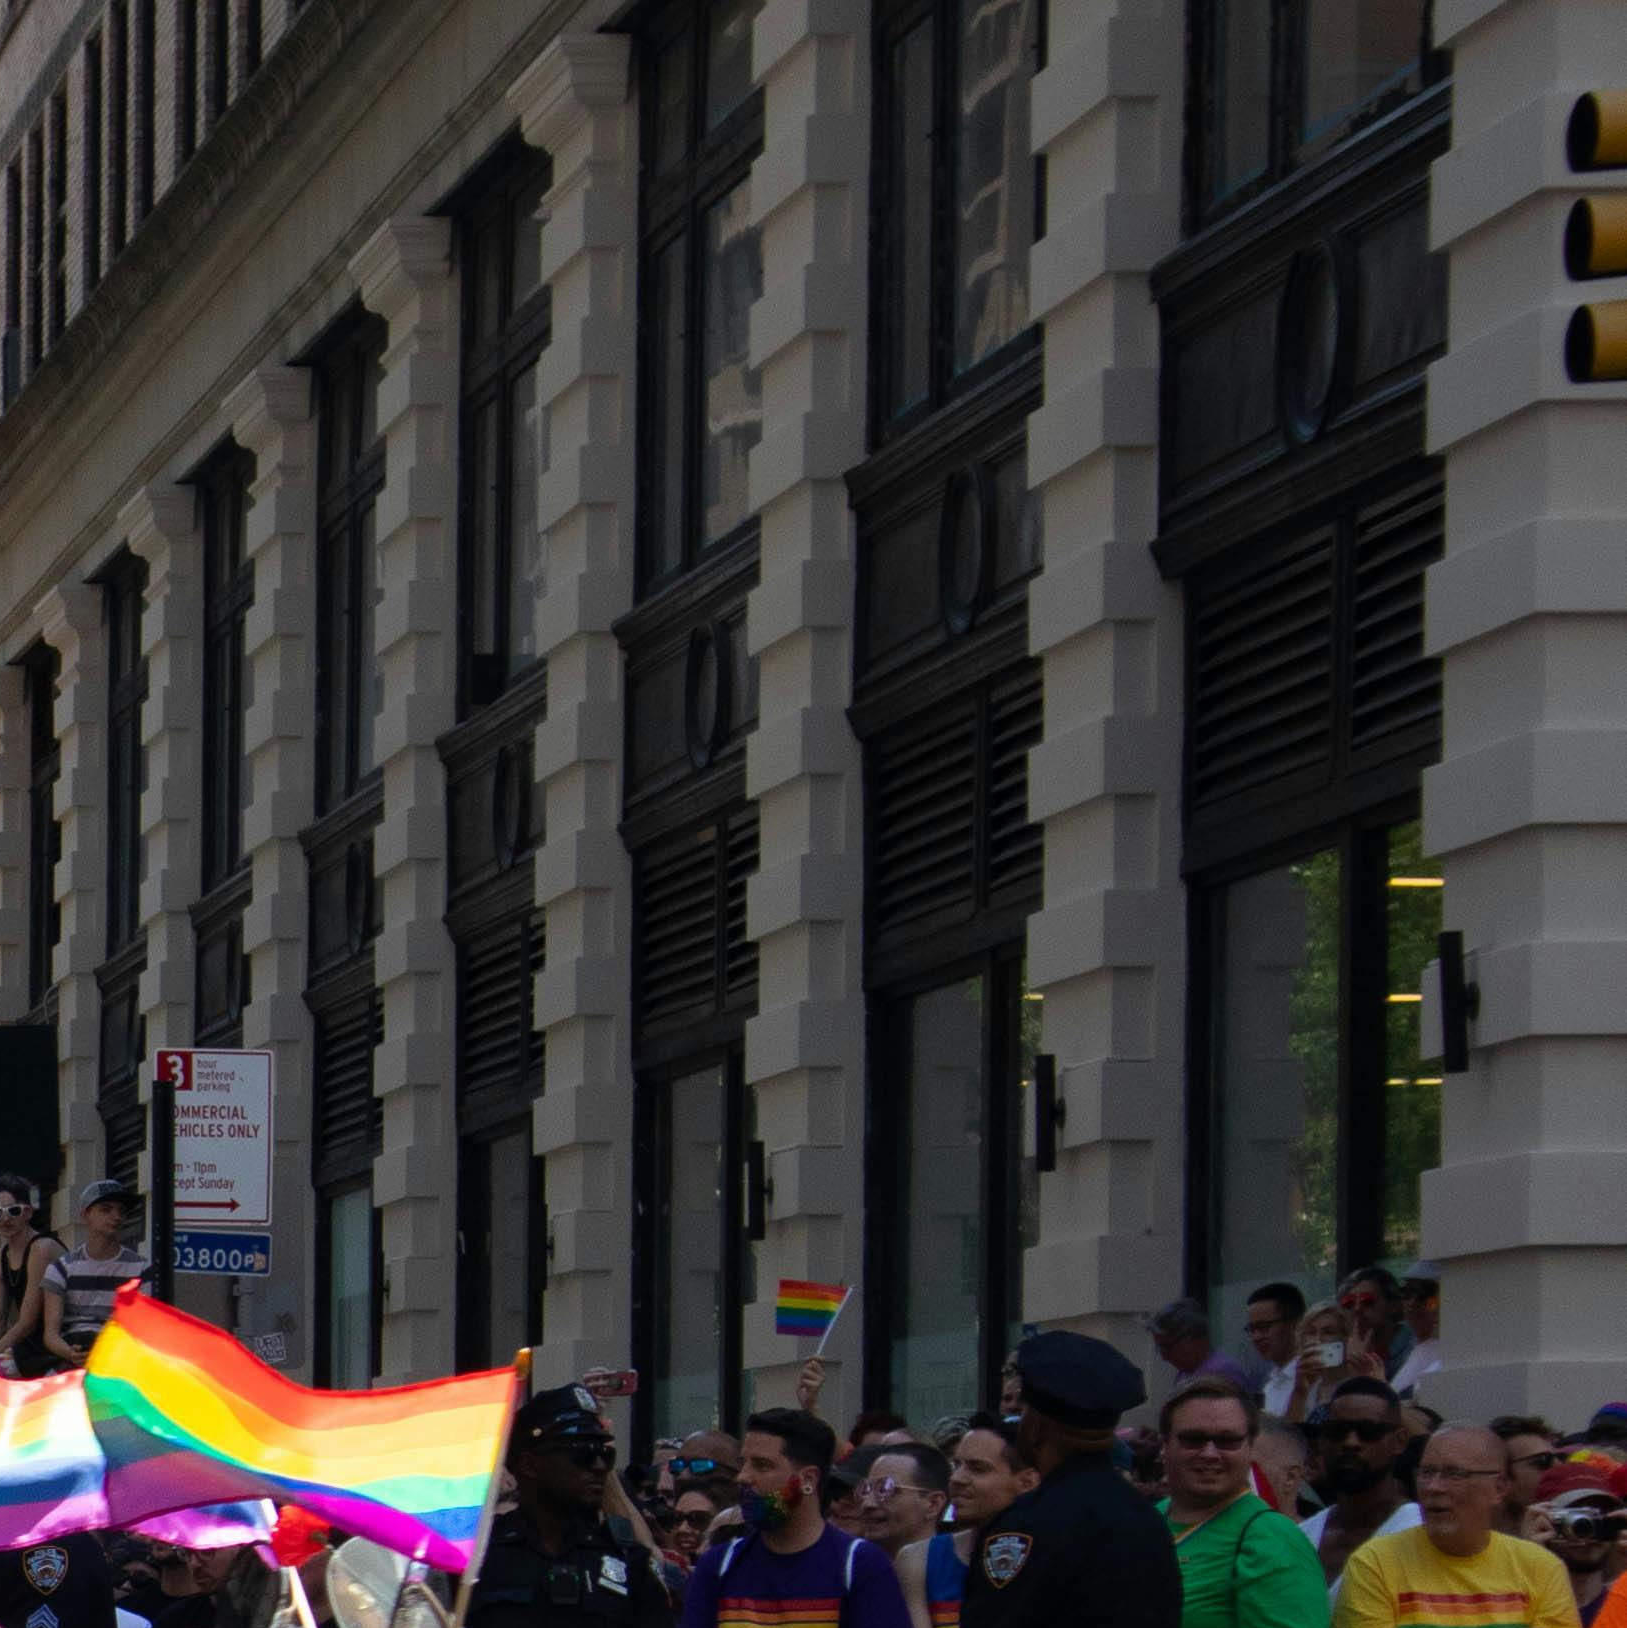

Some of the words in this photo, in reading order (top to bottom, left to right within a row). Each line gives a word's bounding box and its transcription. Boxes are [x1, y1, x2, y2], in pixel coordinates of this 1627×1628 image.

[197, 1058, 217, 1069] hour
[166, 1055, 185, 1088] 3
[197, 1070, 235, 1081] metered
[197, 1082, 230, 1093] parking
[174, 1105, 248, 1120] OMMERCIAL
[174, 1123, 224, 1138] EHICLES
[228, 1124, 260, 1138] ONLY
[174, 1178, 195, 1191] cept
[199, 1177, 234, 1191] Sunday
